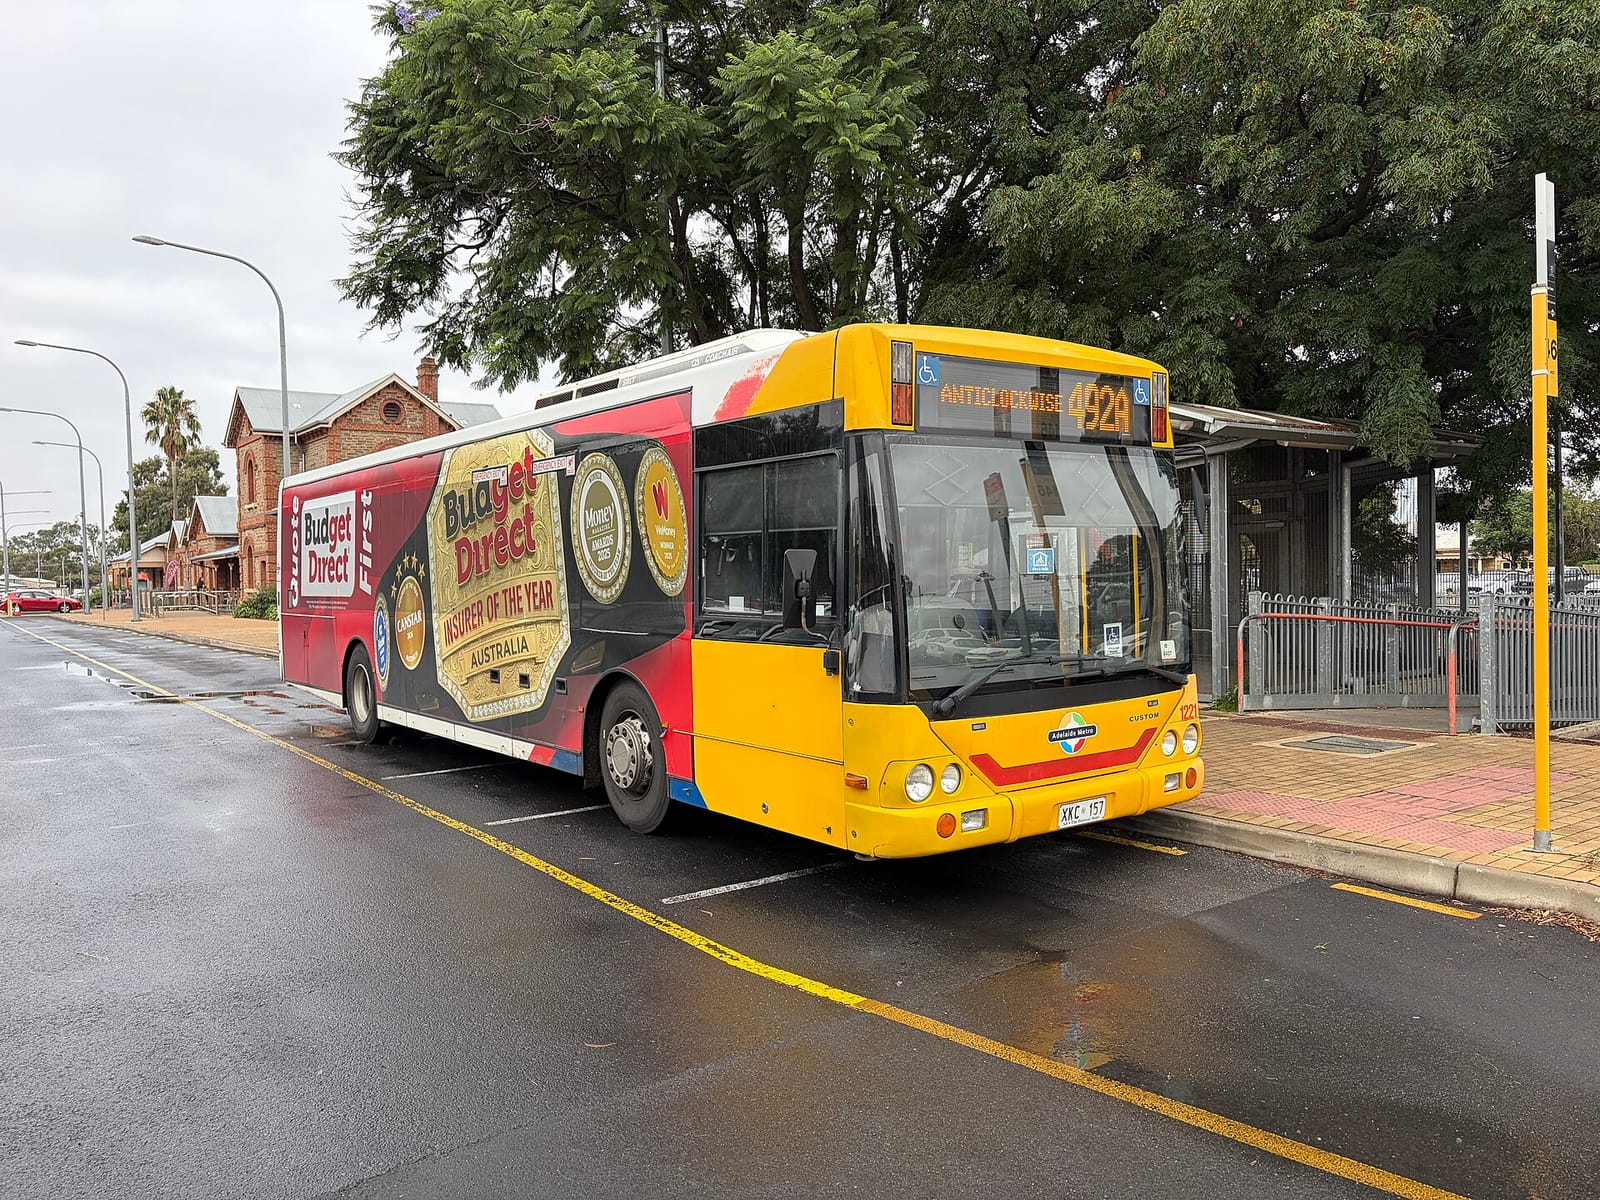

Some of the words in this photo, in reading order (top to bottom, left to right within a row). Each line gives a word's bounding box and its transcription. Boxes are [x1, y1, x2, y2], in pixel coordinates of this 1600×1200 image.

[940, 383, 1064, 413] ANTICLOCKWISE
[1068, 381, 1130, 433] 492A
[443, 445, 537, 539] Budget
[304, 506, 352, 553] Budget
[584, 502, 615, 529] Money
[290, 495, 299, 608] Quote
[359, 489, 373, 596] First
[455, 502, 537, 585] Direct
[591, 534, 614, 551] AWARDS
[597, 548, 611, 561] 2025
[308, 547, 349, 583] Direct
[396, 609, 422, 633] CANSTAR
[443, 599, 484, 647] INSURER
[486, 591, 500, 623] OF
[502, 584, 524, 617] THE
[525, 580, 554, 612] YEAR
[470, 635, 530, 669] AUSTRALIA
[1129, 712, 1160, 722] CUSTOM
[1180, 703, 1197, 721] 1221
[1051, 729, 1076, 739] Adelaide
[1077, 728, 1094, 736] Metro
[1061, 805, 1080, 822] XKC
[1089, 800, 1104, 817] 157
